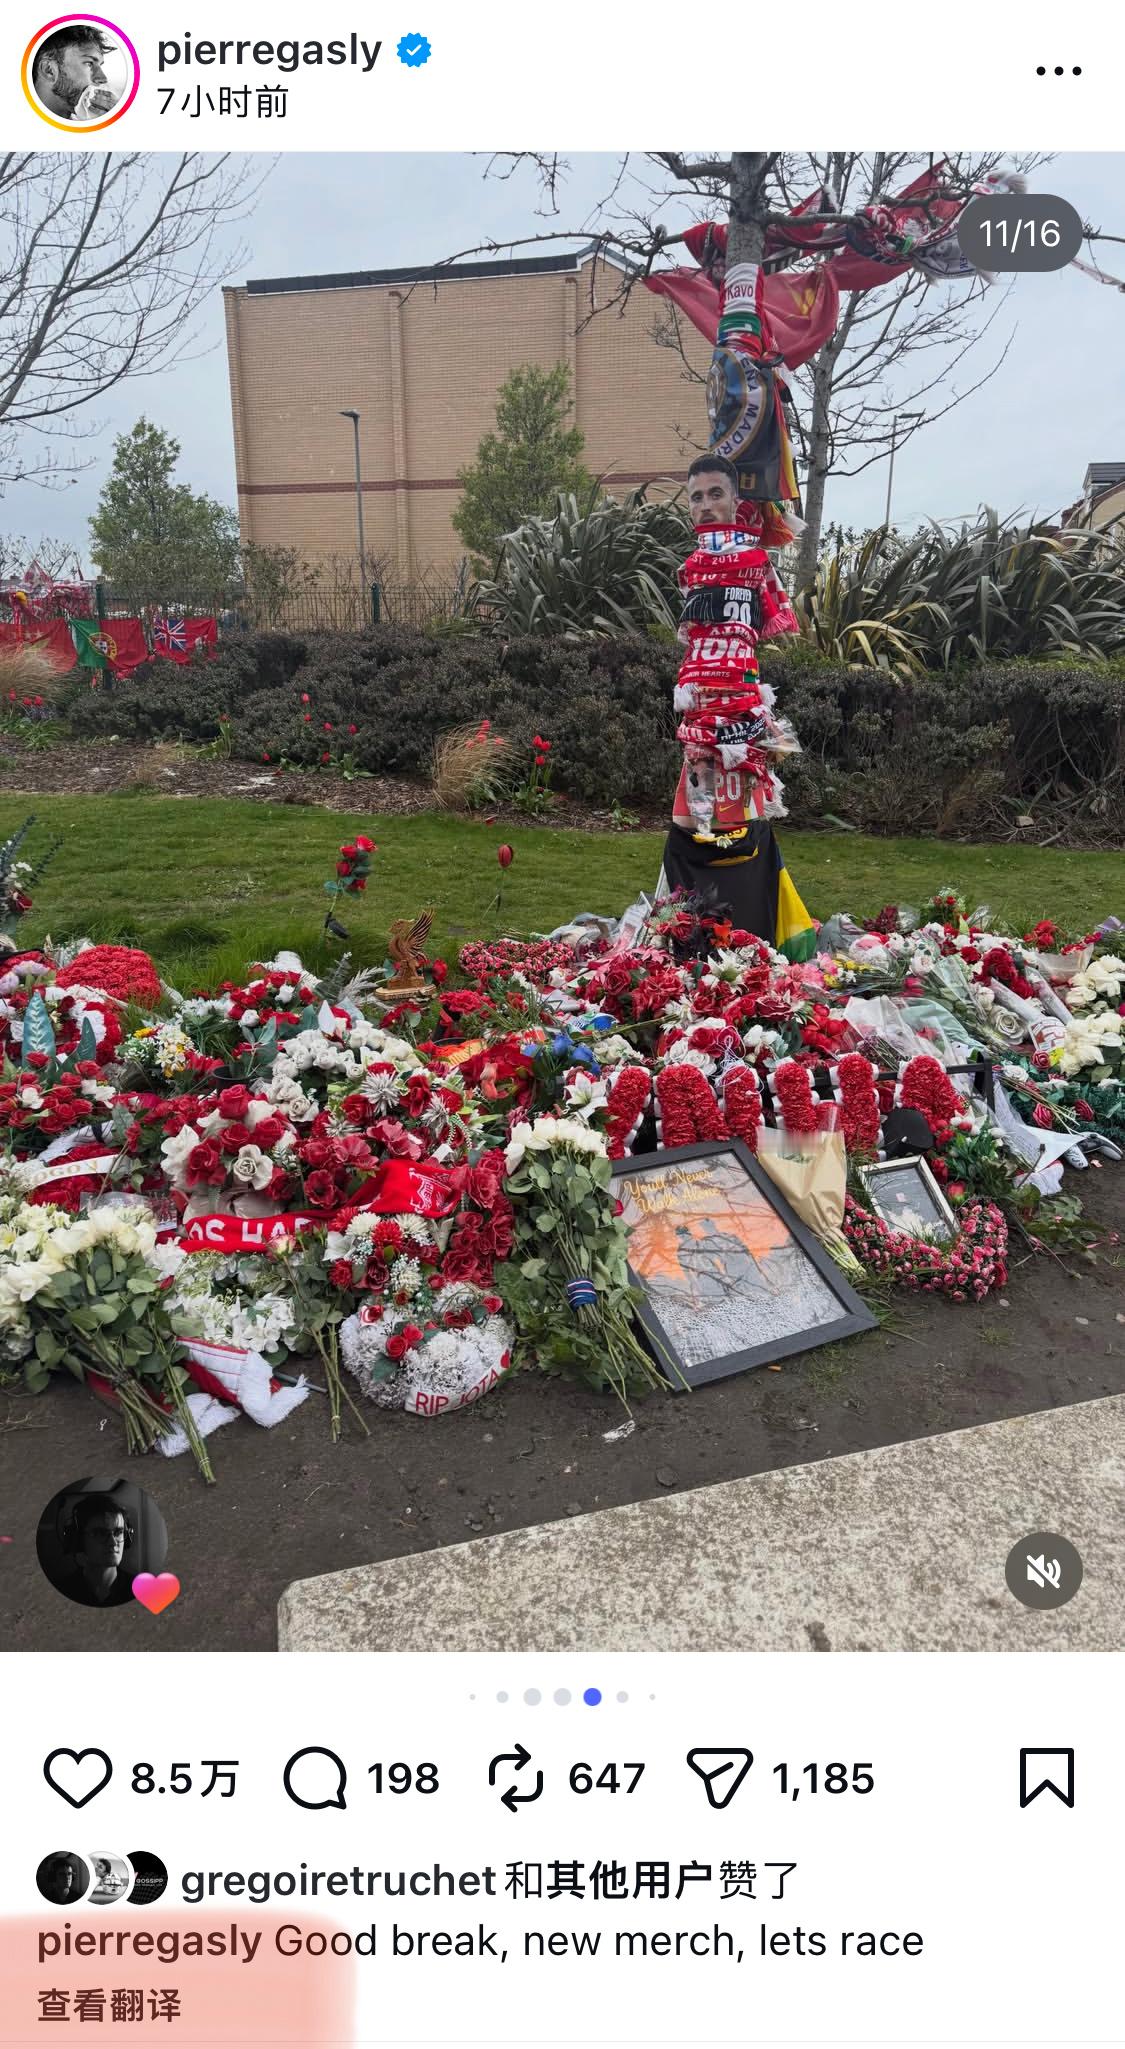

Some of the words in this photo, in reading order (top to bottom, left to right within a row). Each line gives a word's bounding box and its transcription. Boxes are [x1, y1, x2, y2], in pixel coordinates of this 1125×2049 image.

[712, 554, 739, 565] 2012
[725, 586, 752, 602] FOREVER
[723, 601, 752, 629] 20
[715, 771, 741, 802] 20
[416, 1391, 449, 1415] RIP
[454, 1368, 498, 1409] JOTA
